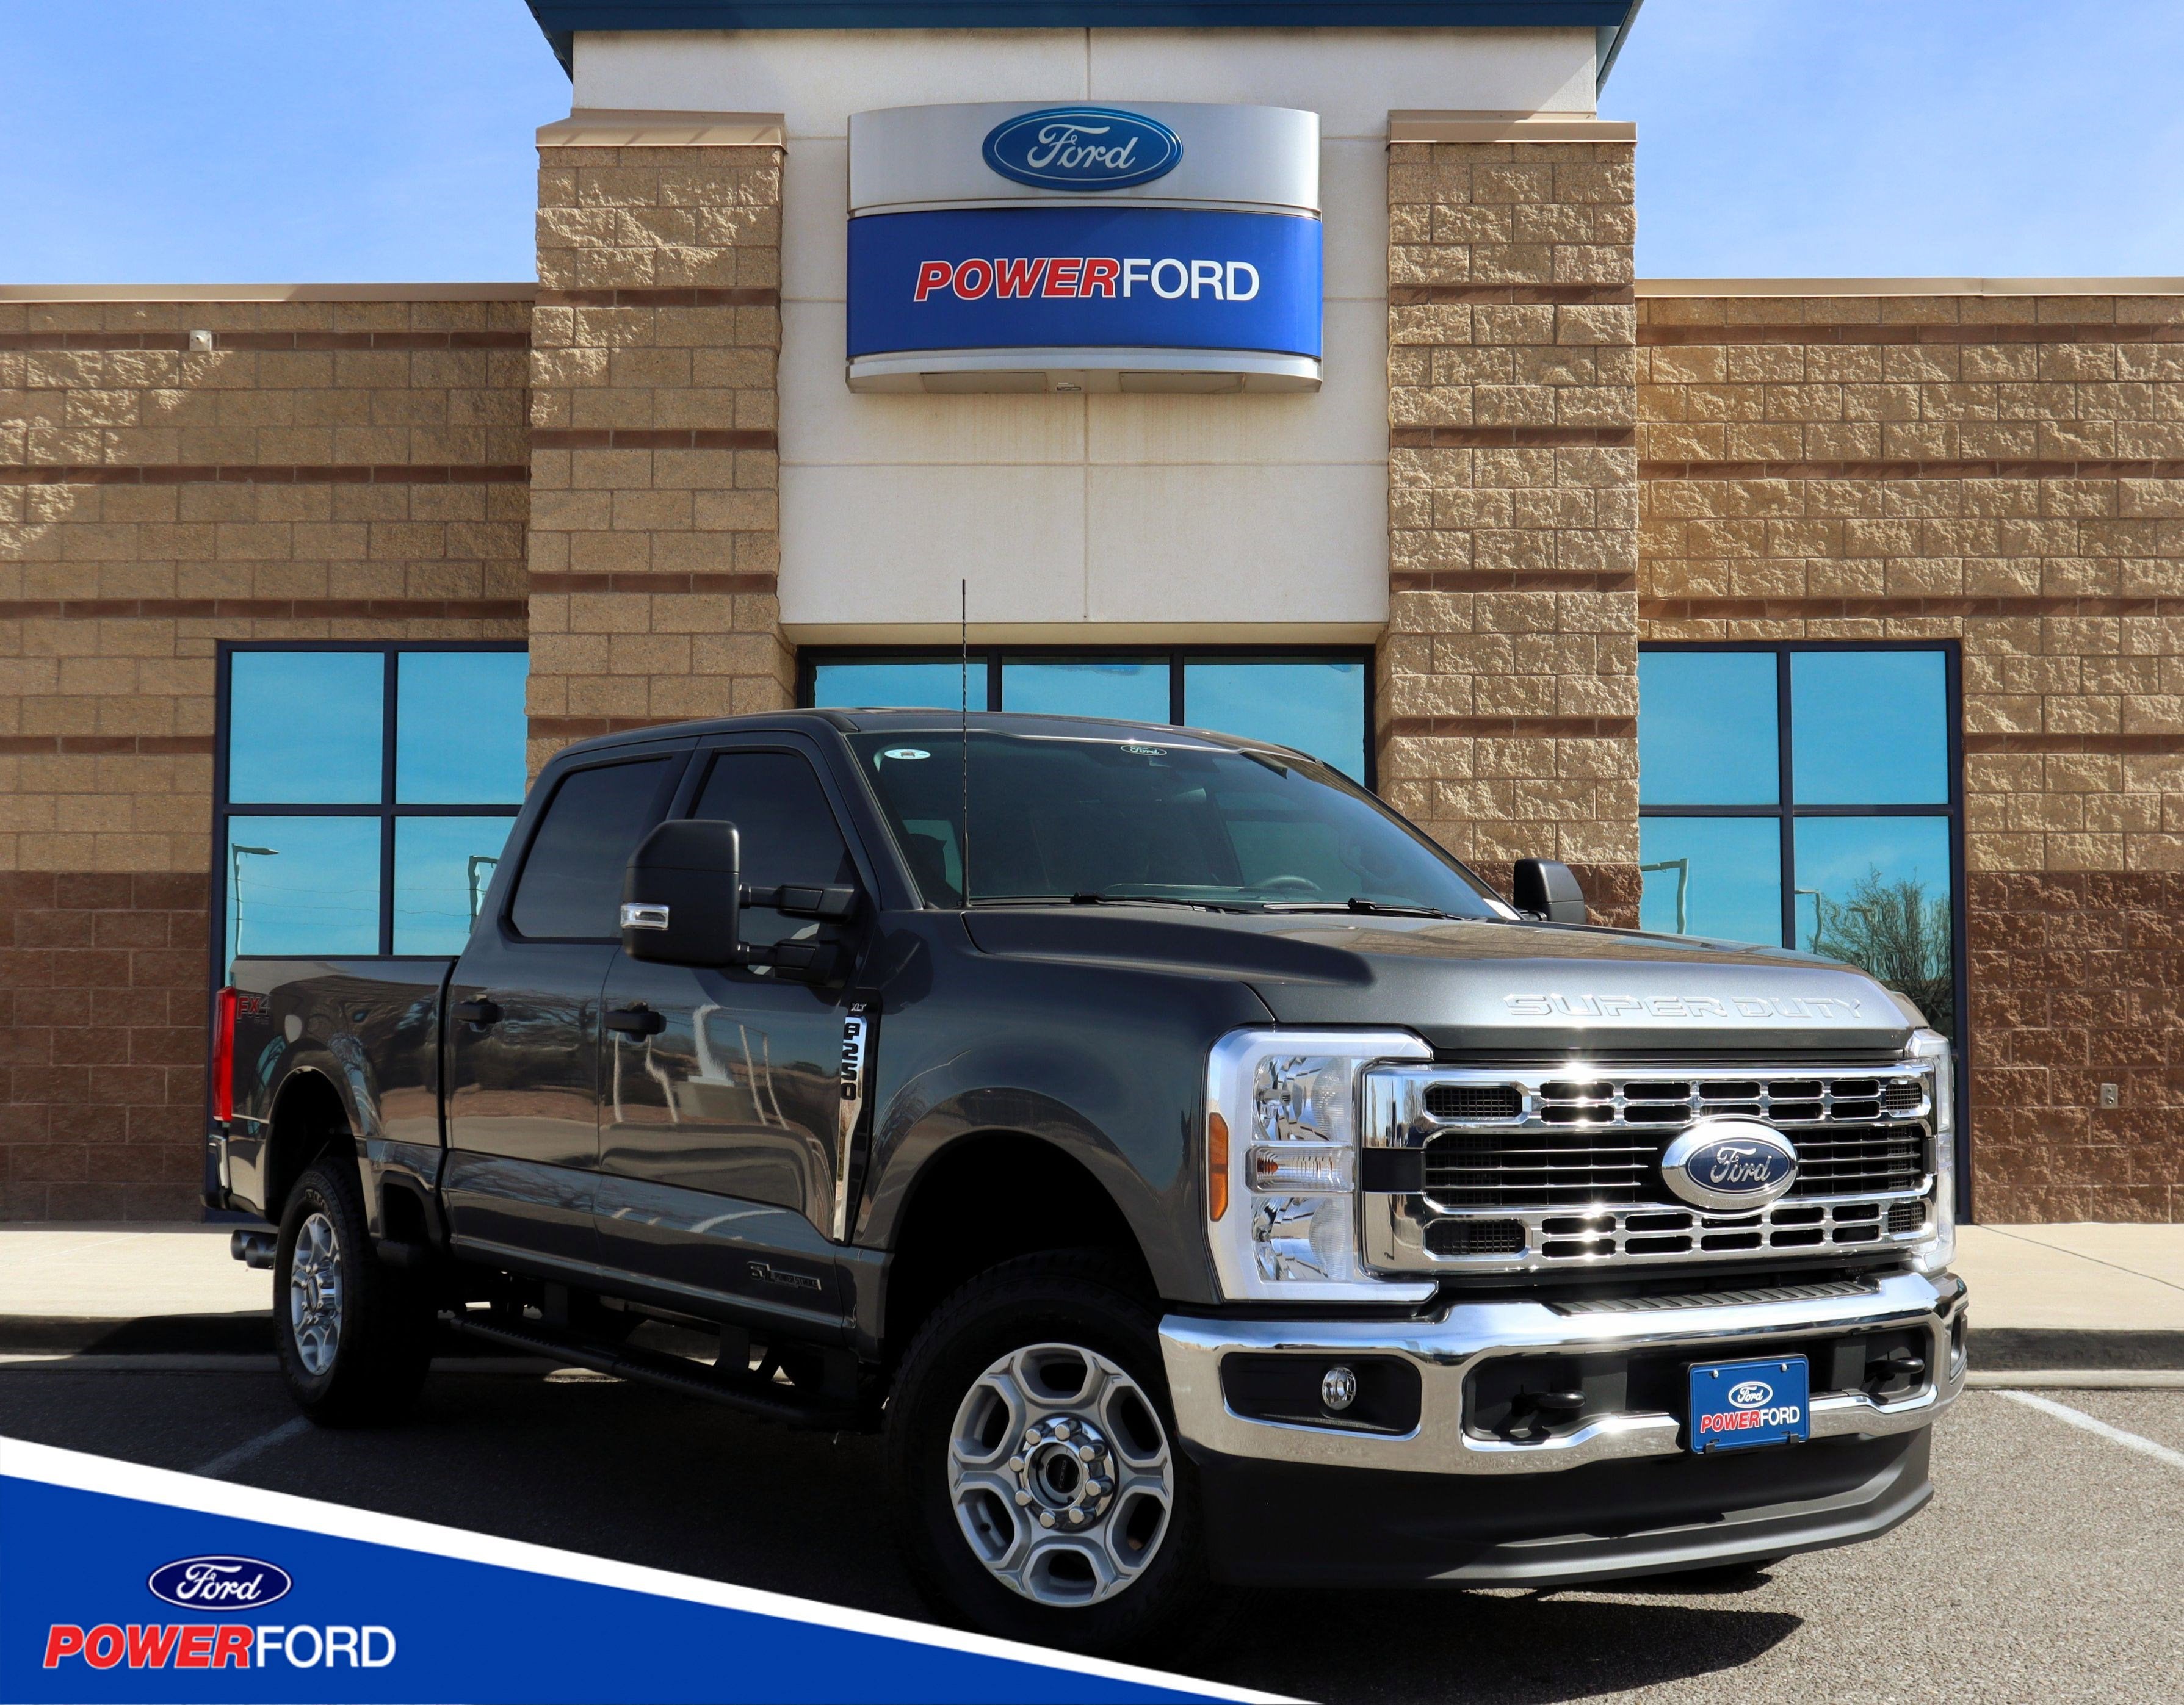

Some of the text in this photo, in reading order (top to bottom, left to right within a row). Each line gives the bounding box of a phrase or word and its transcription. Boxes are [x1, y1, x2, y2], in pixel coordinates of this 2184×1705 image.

[1027, 124, 1139, 170] Ford
[913, 257, 1260, 302] POWERFORD
[1130, 746, 1159, 754] Ford
[236, 994, 272, 1023] FX4
[850, 1003, 867, 1012] XLT
[1503, 993, 1861, 1018] SUPER DUTY
[1710, 1147, 1772, 1183] Ford
[1737, 1386, 1763, 1403] Ford
[1701, 1406, 1800, 1433] POWERFORD
